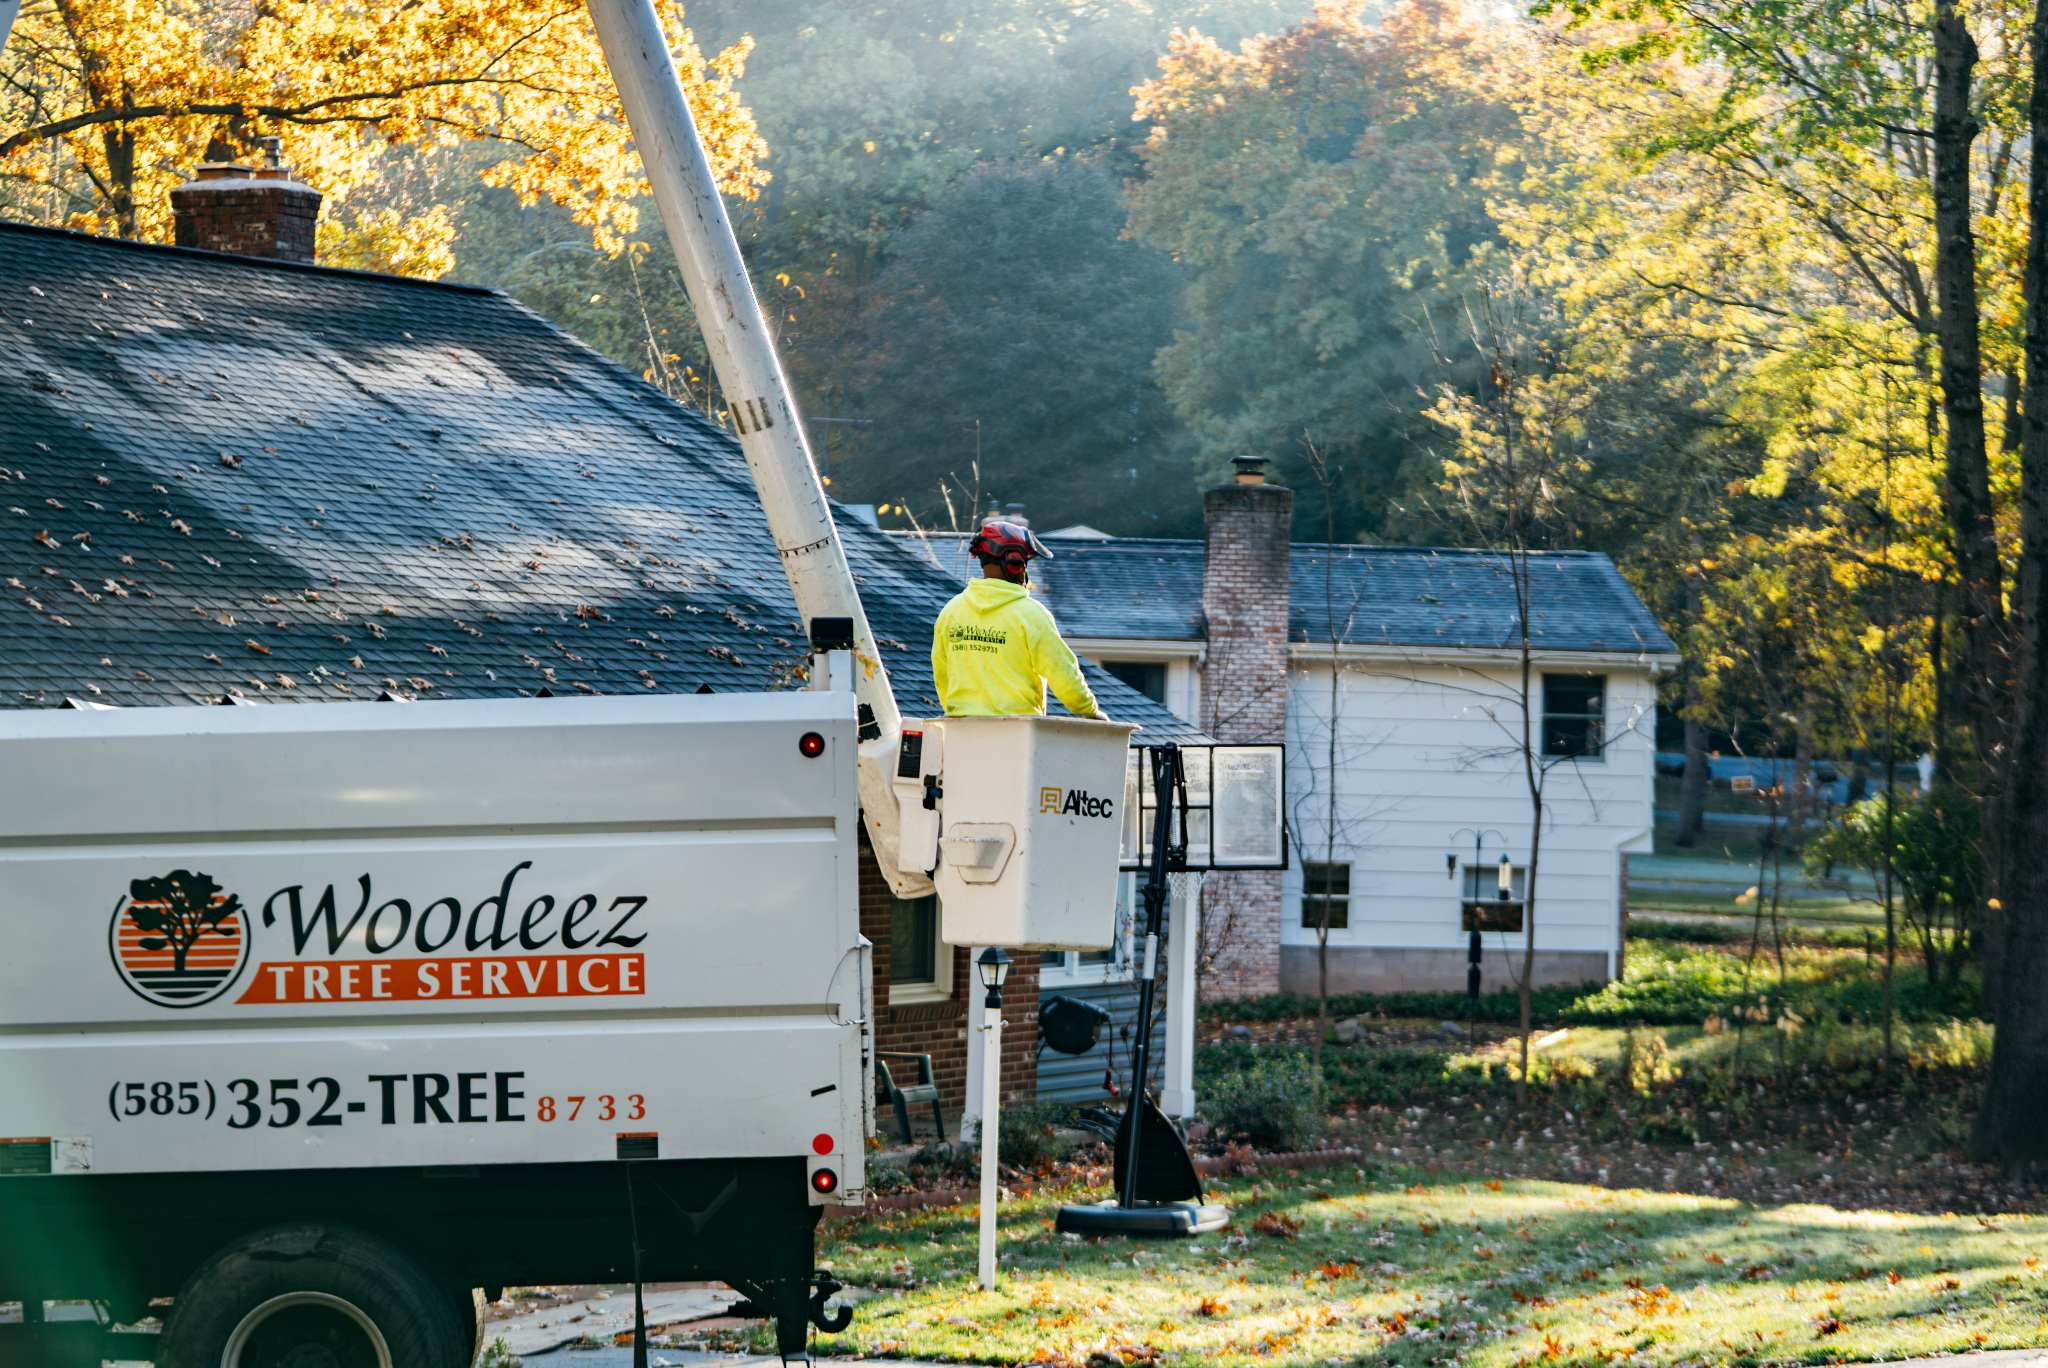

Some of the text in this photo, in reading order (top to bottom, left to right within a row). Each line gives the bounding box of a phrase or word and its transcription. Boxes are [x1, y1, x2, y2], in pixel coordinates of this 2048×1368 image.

[1061, 789, 1114, 819] Altec
[262, 861, 647, 957] Woodeez
[268, 957, 642, 1001] TREE SERVICE
[108, 1079, 217, 1123] (585)
[226, 1071, 526, 1130] 352-TREE
